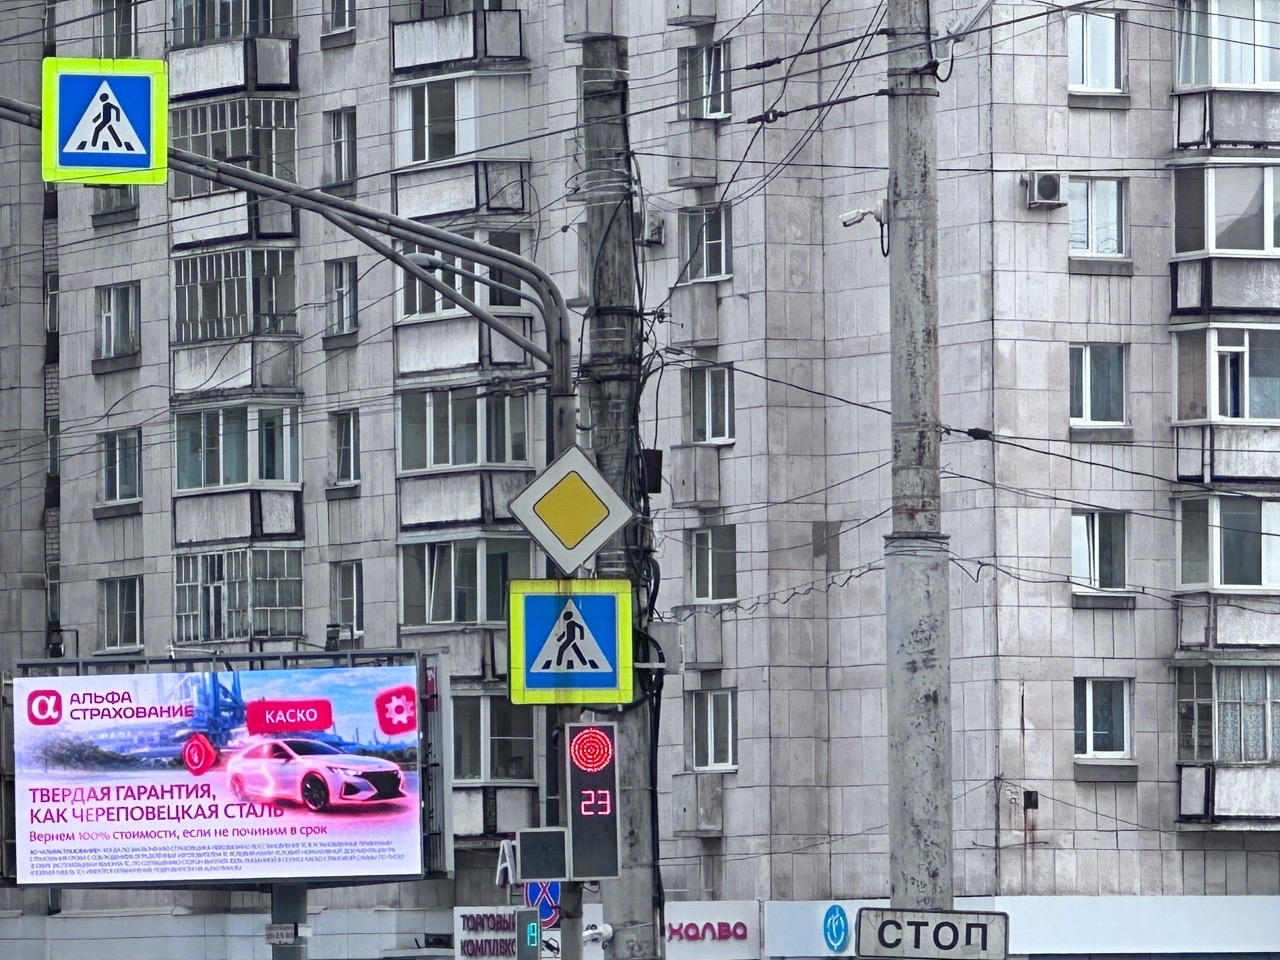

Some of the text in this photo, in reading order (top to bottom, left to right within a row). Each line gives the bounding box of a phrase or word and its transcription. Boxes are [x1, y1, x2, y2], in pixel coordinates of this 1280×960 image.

[70, 691, 133, 705] АЛЬФА
[70, 705, 195, 720] СТРАХОВАНИЕ
[265, 708, 318, 724] КАСКО
[29, 783, 217, 805] ТВЕРДАЯ ГАРАНТИЯ,
[581, 790, 611, 816] 23
[29, 803, 284, 824] КАК ЧЕРЕПОВЕЦКАЯ СТАЛЬ
[29, 830, 75, 845] Вернем
[183, 828, 211, 838] если
[214, 828, 228, 838] не
[232, 826, 287, 837] починим
[290, 826, 297, 835] в
[299, 825, 327, 838] срок
[877, 919, 988, 952] СТОП
